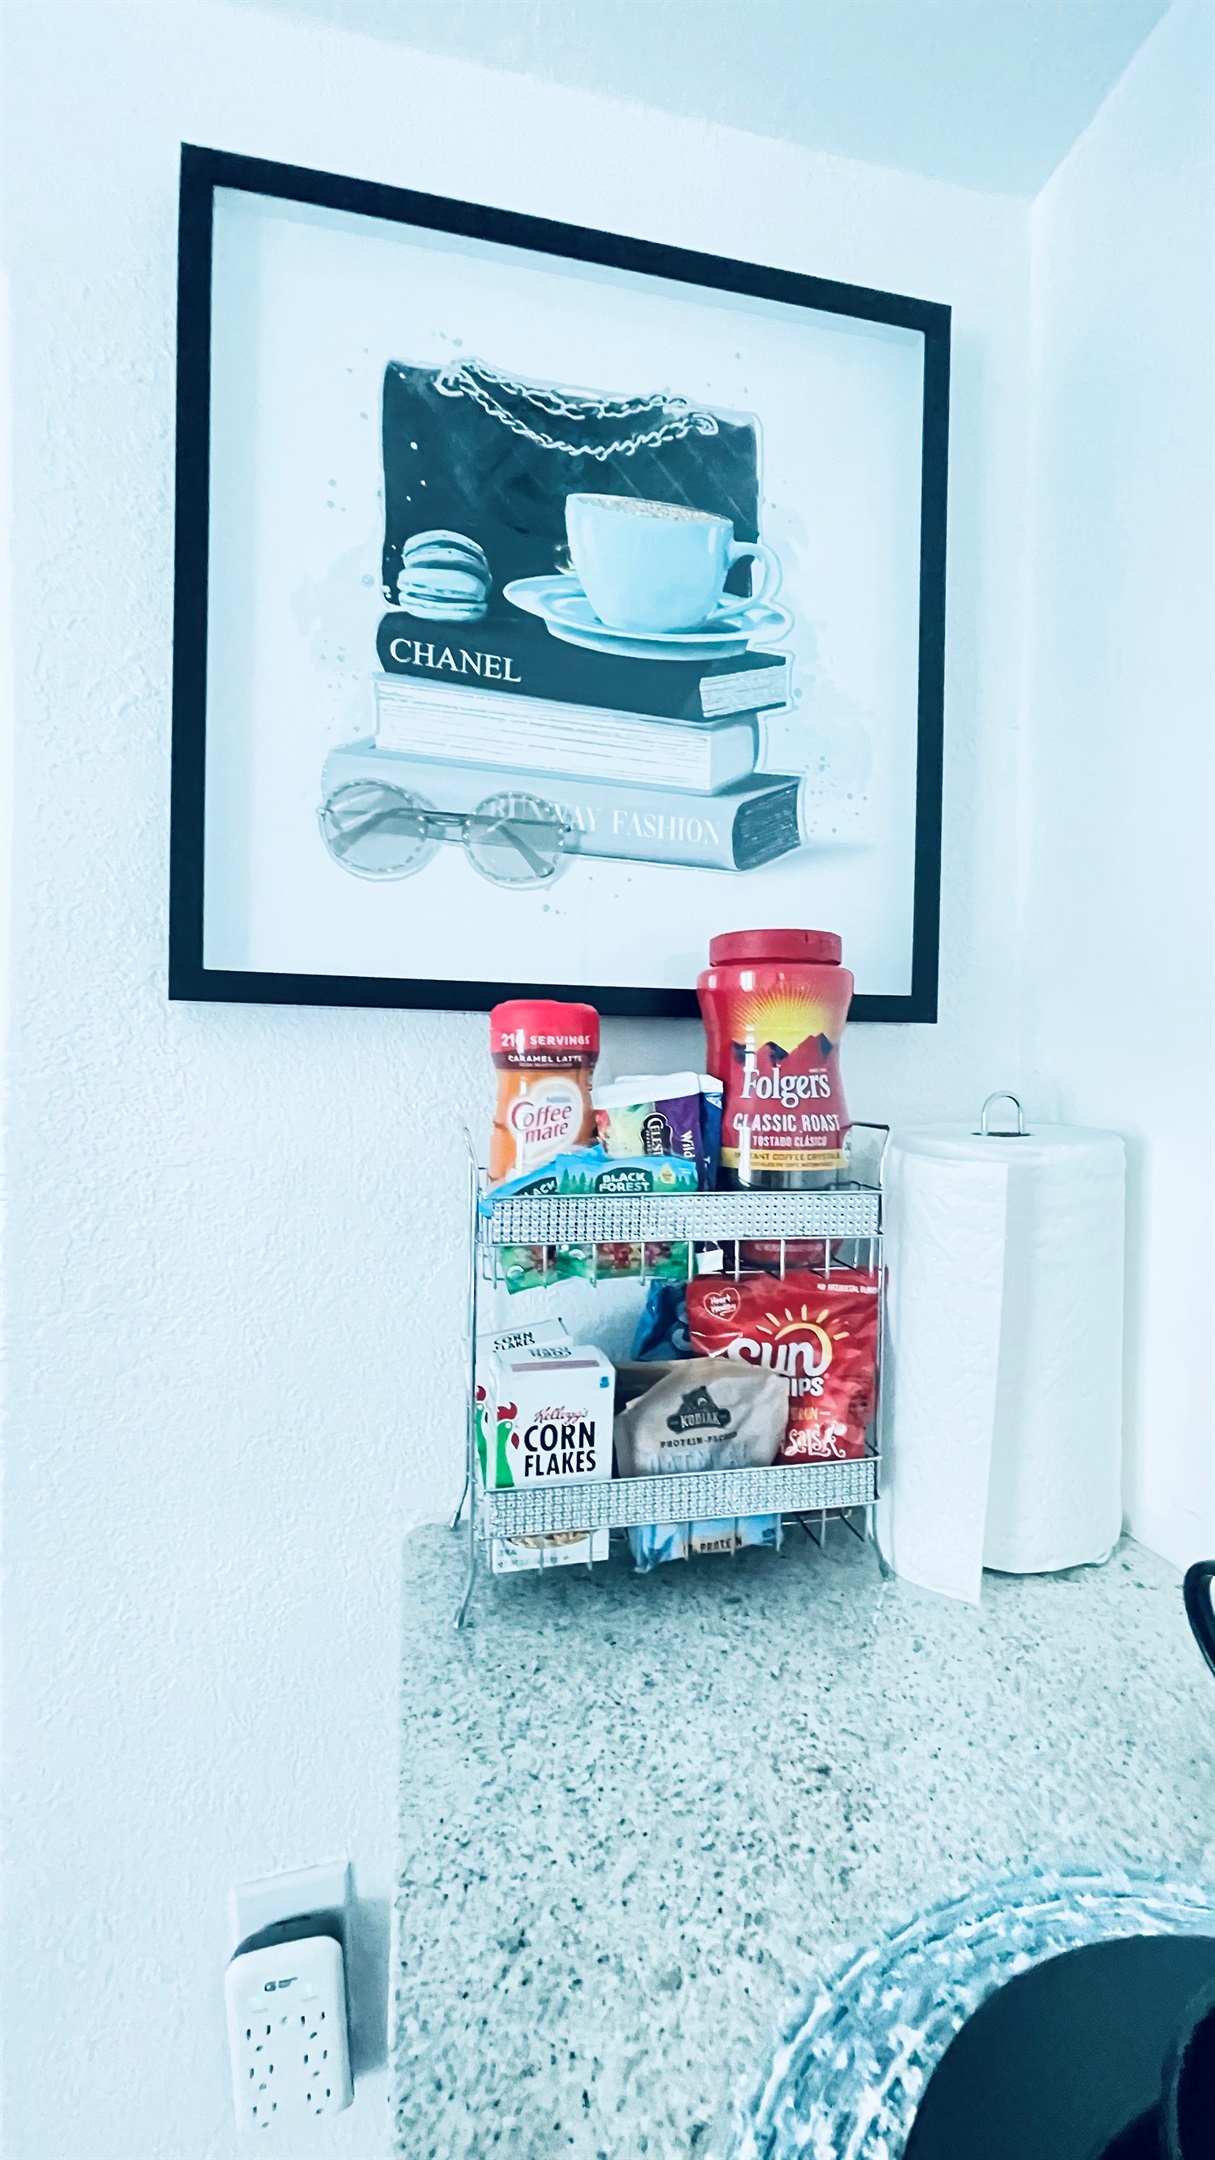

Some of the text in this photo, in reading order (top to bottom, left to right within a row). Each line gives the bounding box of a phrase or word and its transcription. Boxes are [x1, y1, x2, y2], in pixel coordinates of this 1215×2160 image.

[389, 637, 522, 683] CHANEL
[612, 809, 720, 846] FASHION
[530, 1035, 590, 1046] SERVINGS
[508, 1055, 583, 1063] CARAMEL LATTE
[740, 1064, 831, 1109] Folgers
[511, 1101, 572, 1132] Coffee
[733, 1112, 840, 1133] CLASSIC ROAST
[525, 1121, 569, 1143] mate
[752, 1135, 792, 1147] TOSTADO
[680, 1130, 696, 1159] Wild
[598, 1182, 651, 1193] FOREST
[602, 1172, 646, 1183] BLACK
[789, 1377, 824, 1397] IPS
[534, 1406, 589, 1425] Kellogg's
[680, 1412, 721, 1429] KODIAK
[524, 1421, 596, 1452] CORN
[524, 1450, 596, 1477] FLAKES
[700, 1536, 742, 1551] PROTEN
